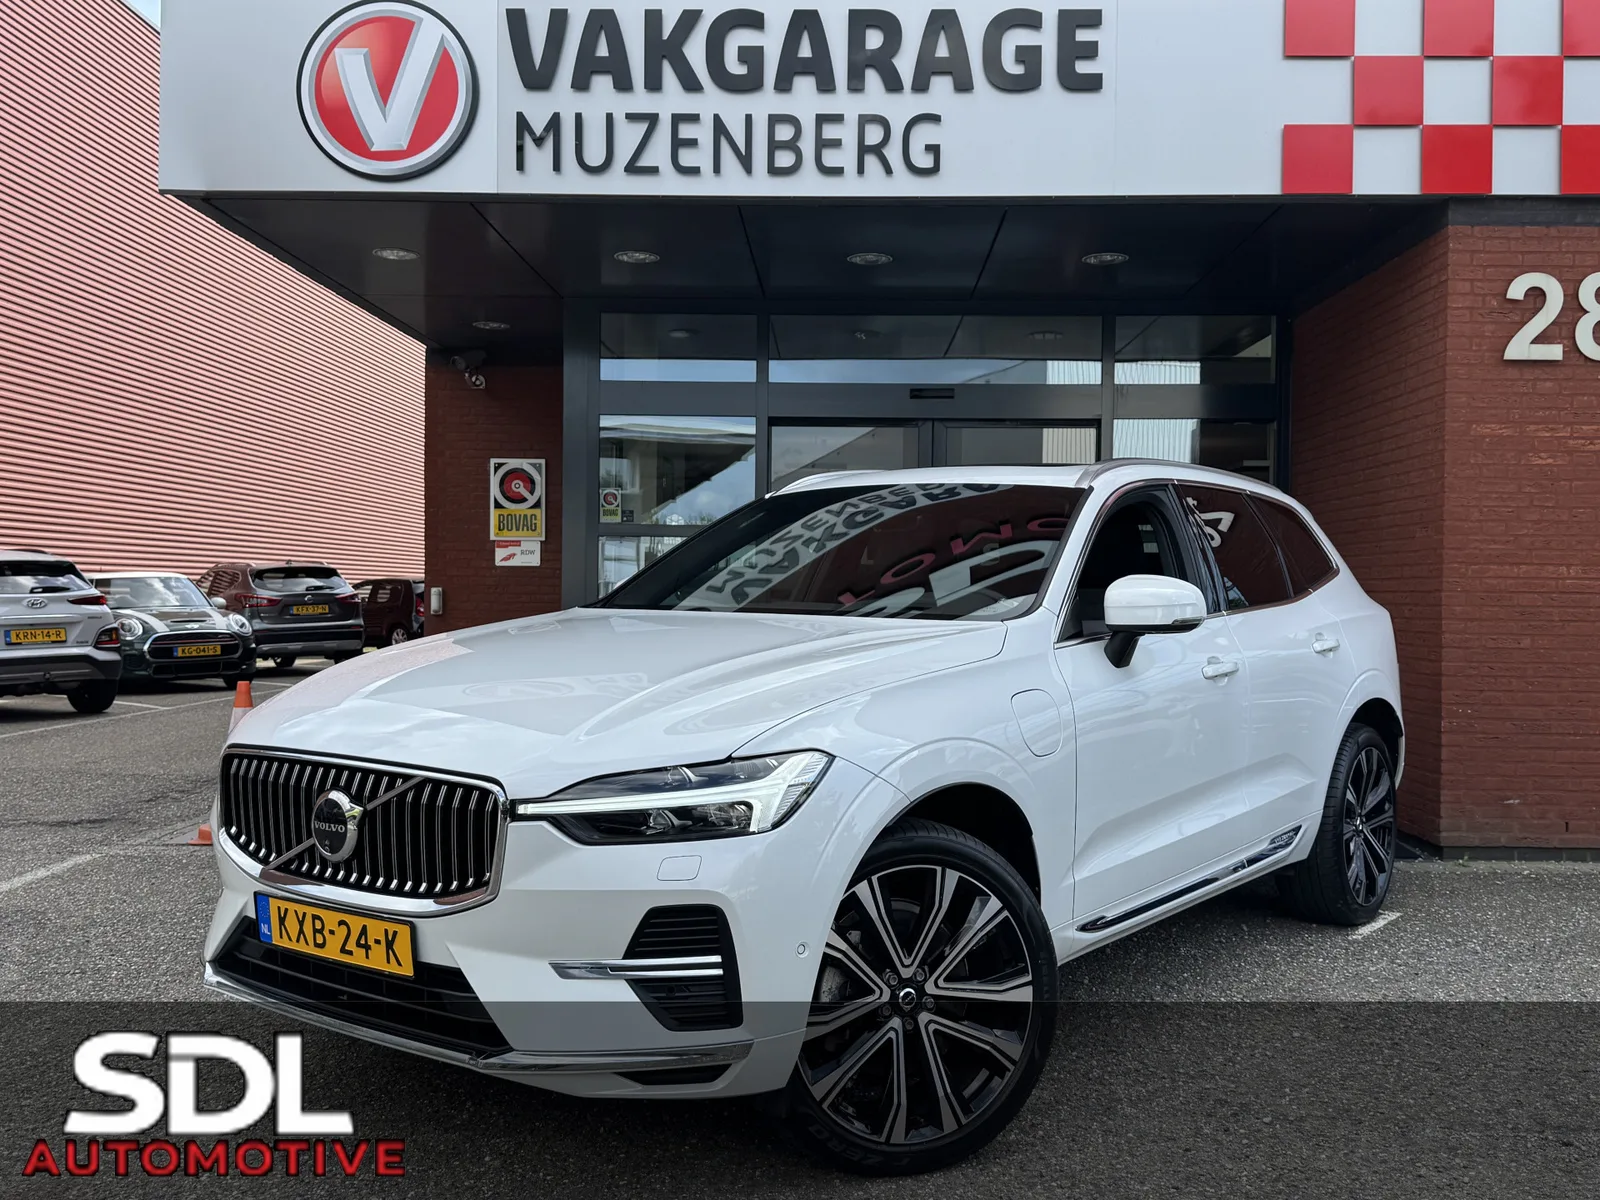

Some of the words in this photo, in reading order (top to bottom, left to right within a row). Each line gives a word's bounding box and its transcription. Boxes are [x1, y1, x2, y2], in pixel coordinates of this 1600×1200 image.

[505, 8, 1103, 91] VAKGARAGE
[516, 111, 942, 175] MUZENBERG
[498, 513, 538, 532] BOVAG
[15, 629, 62, 641] KRN-14-R
[181, 646, 218, 655] KG-041-S
[314, 820, 346, 833] VOLVO
[261, 923, 271, 935] NL
[277, 905, 403, 967] KXB-24-K
